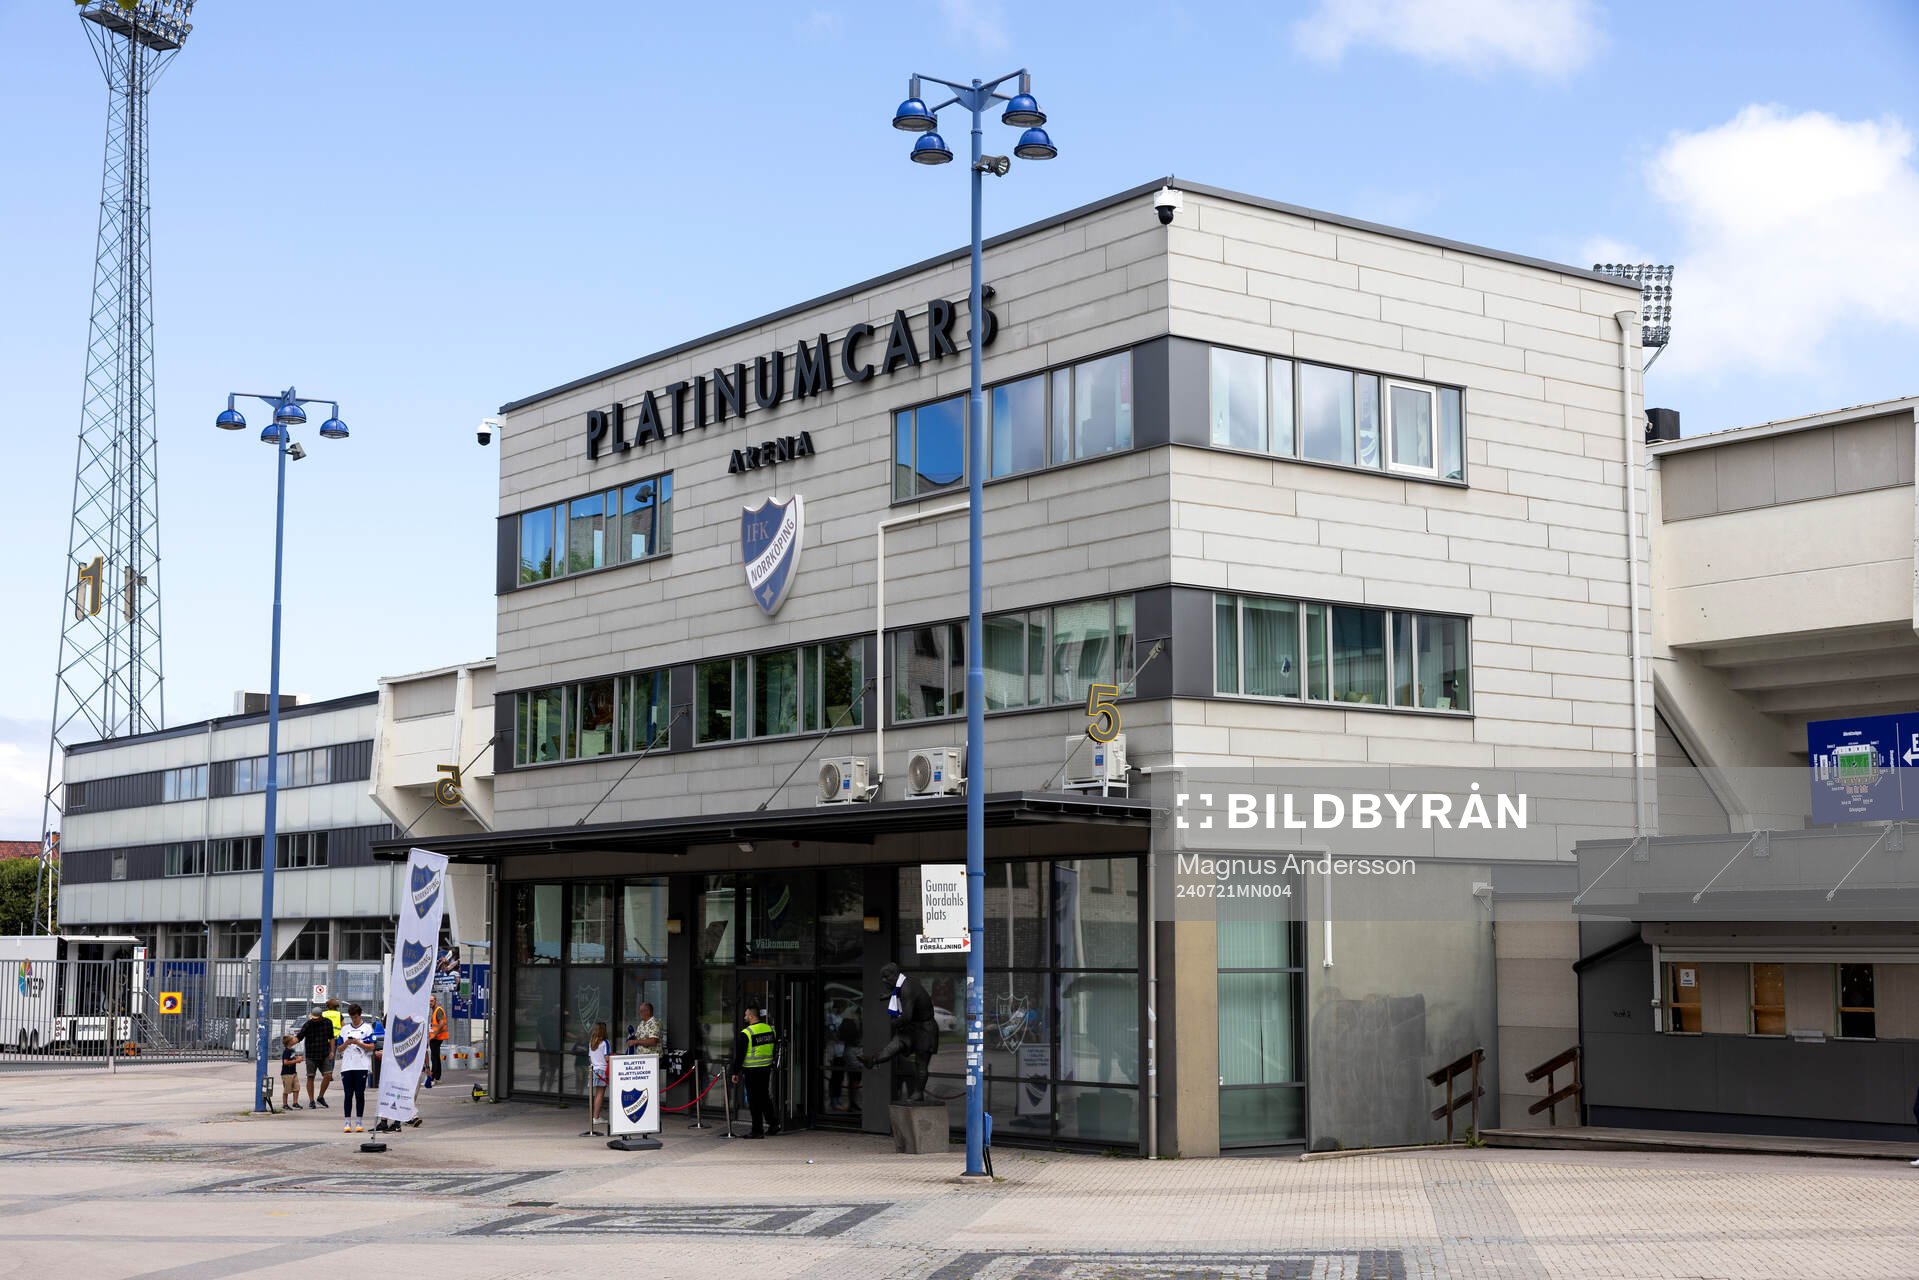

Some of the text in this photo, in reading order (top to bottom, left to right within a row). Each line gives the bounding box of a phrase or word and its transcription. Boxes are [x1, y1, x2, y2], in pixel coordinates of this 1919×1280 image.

[587, 285, 999, 460] PLATINUMCARS
[728, 431, 815, 473] ARENA
[747, 521, 769, 543] IFK
[750, 518, 795, 584] NORRKÖPING
[1086, 683, 1121, 743] 5
[925, 880, 957, 892] Gunnar
[926, 893, 964, 906] Nordahls
[926, 907, 947, 923] plats
[756, 938, 800, 949] Välkommen
